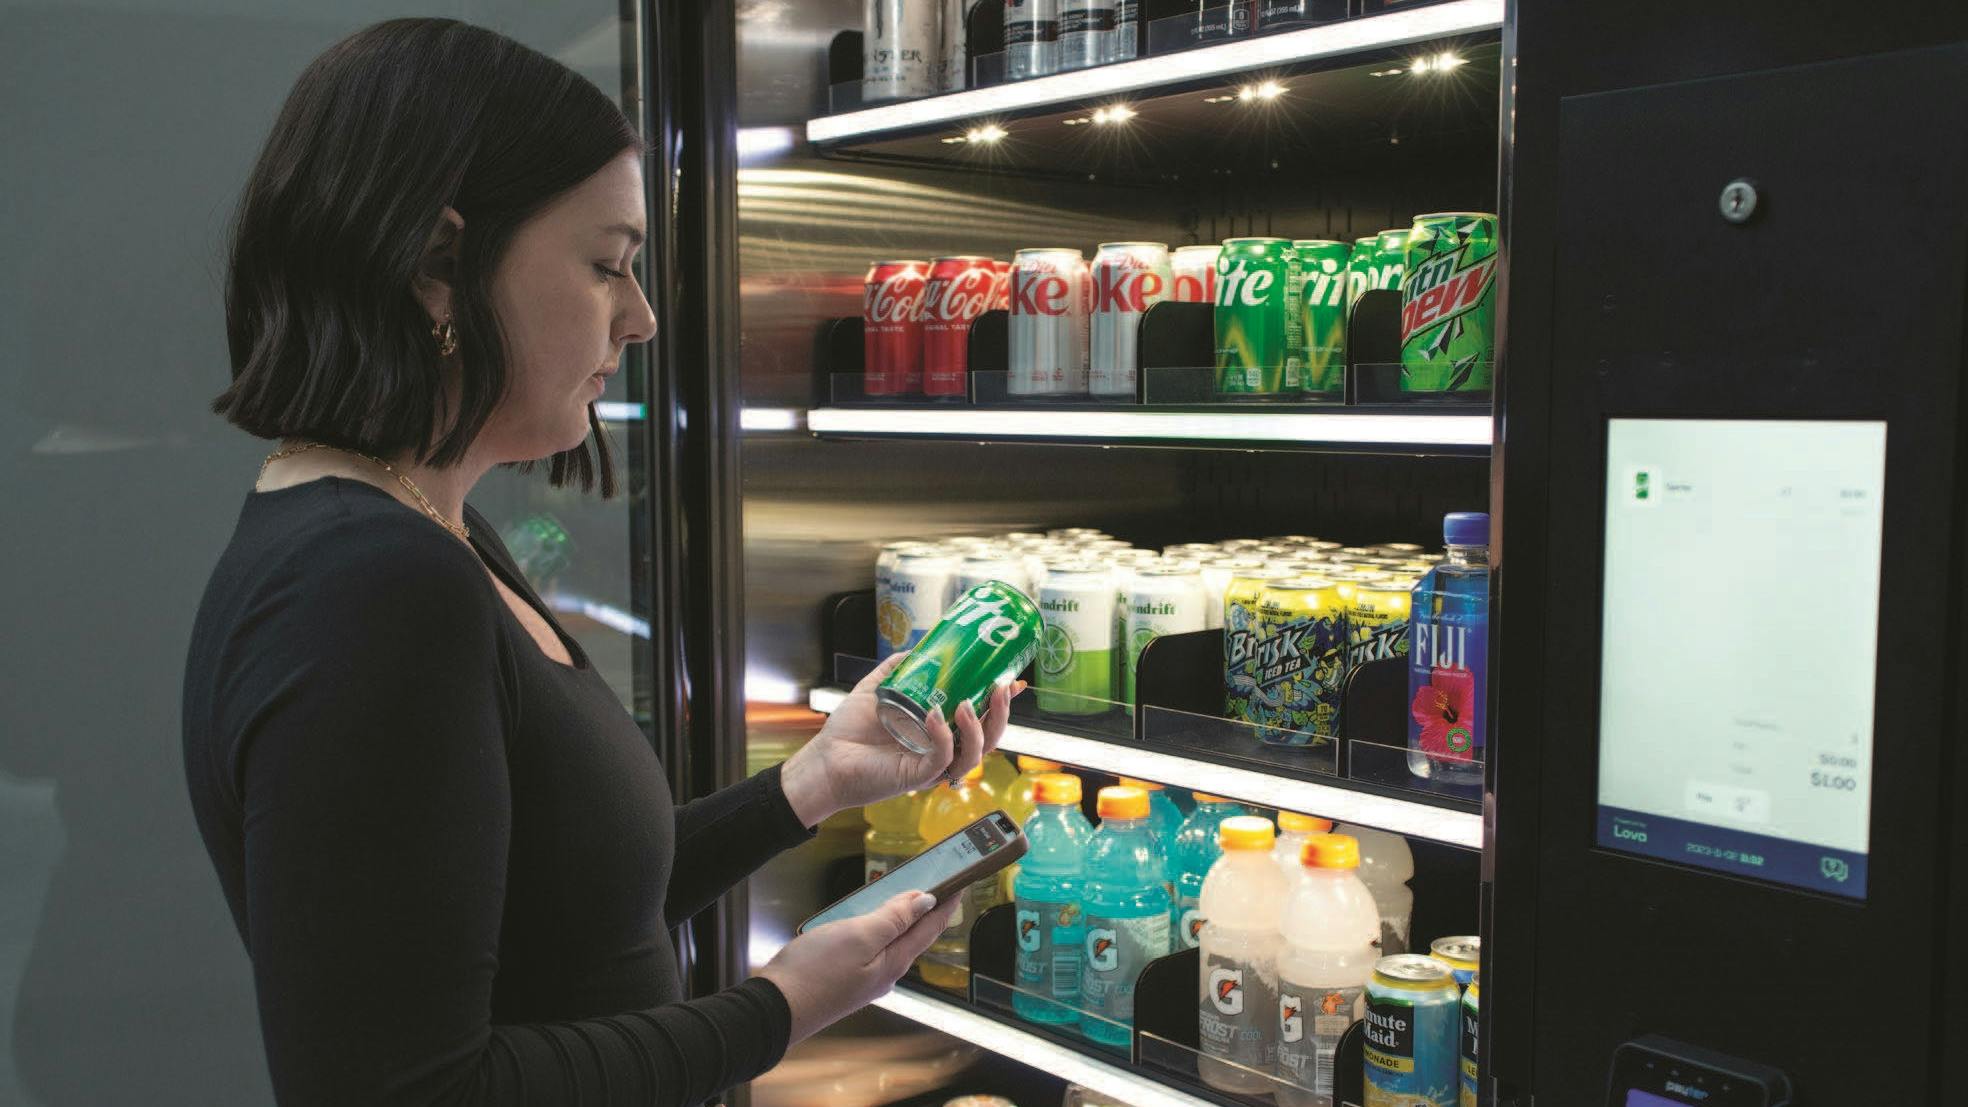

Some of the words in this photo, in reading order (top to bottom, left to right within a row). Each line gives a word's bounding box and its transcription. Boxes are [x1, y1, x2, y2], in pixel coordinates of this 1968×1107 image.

[1415, 622, 1466, 671] FIJI
[1264, 664, 1283, 681] ICED
[1284, 658, 1302, 673] TEA
[1811, 771, 1857, 792] $1.00
[1086, 928, 1119, 971] G
[1209, 968, 1244, 1016] G
